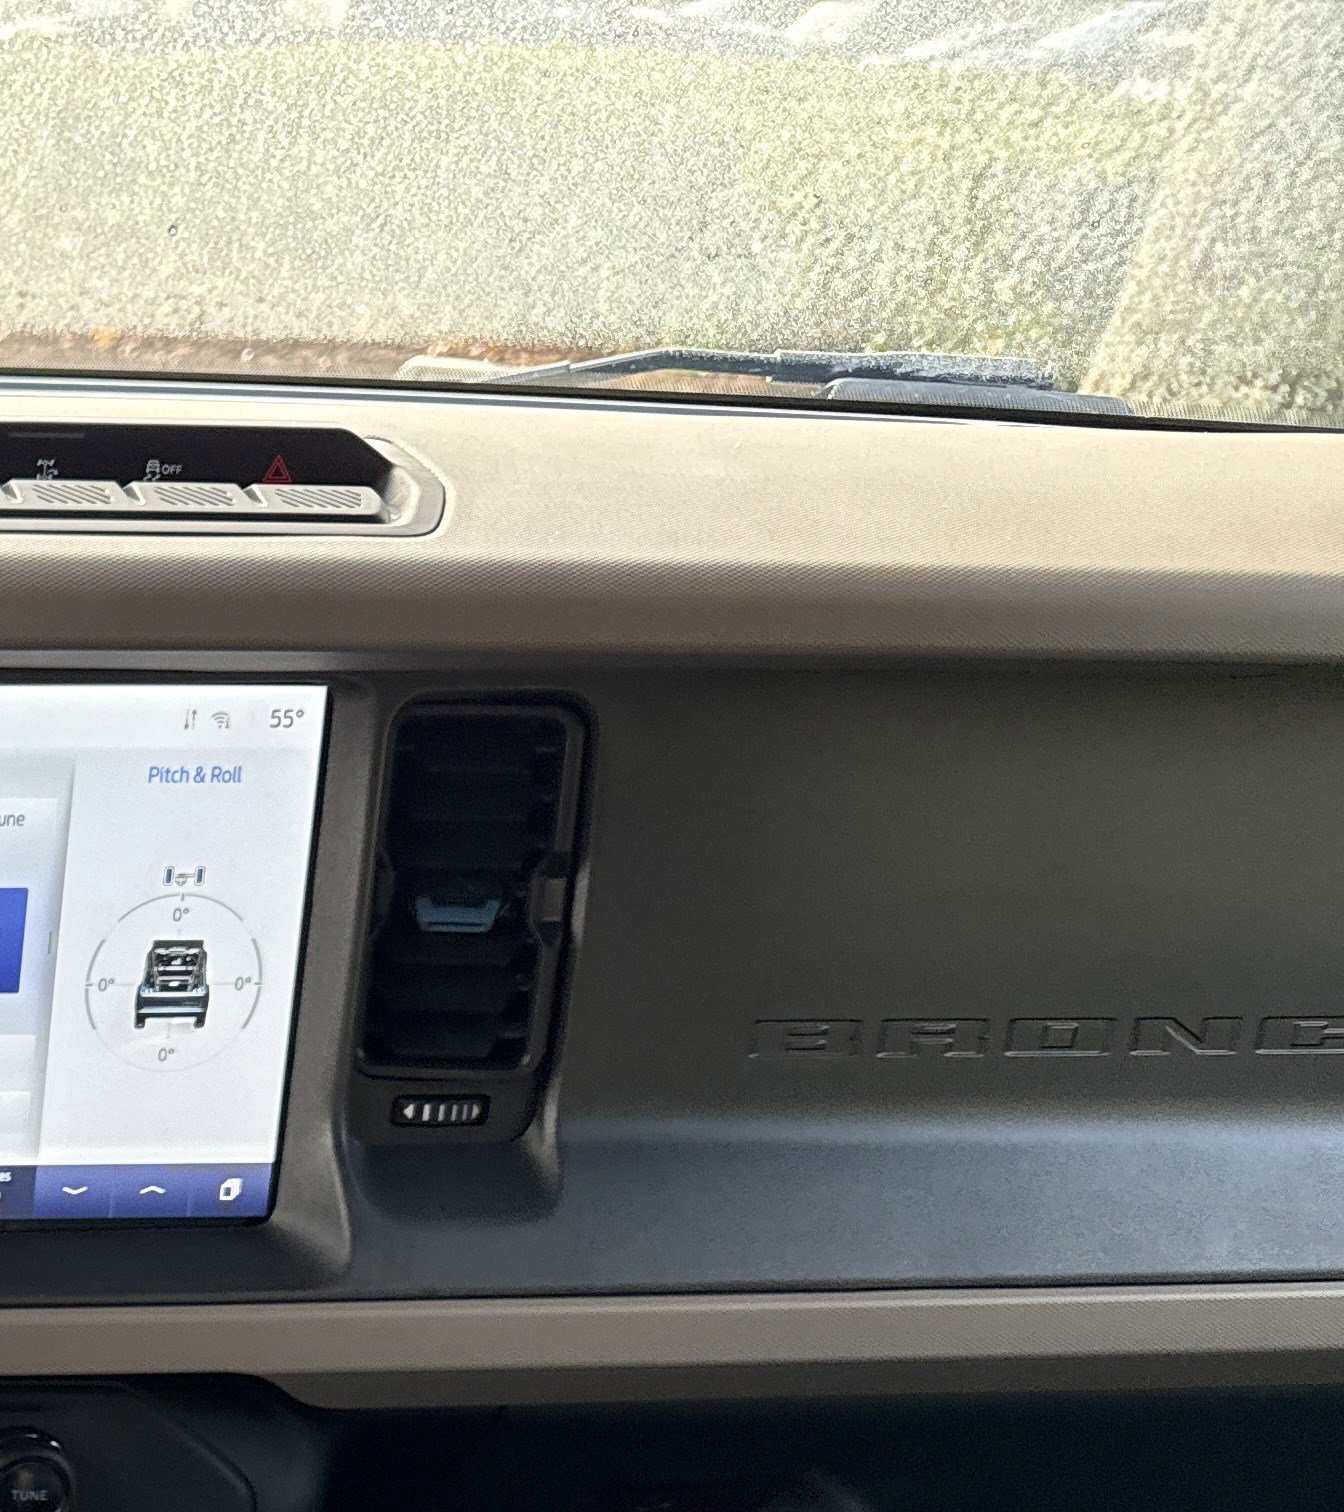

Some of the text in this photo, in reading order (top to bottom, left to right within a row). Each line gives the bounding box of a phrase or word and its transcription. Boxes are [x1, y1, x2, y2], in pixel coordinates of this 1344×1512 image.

[162, 464, 182, 475] OFF
[148, 766, 242, 784] Pitch & Roll
[11, 1489, 48, 1501] TUNE
